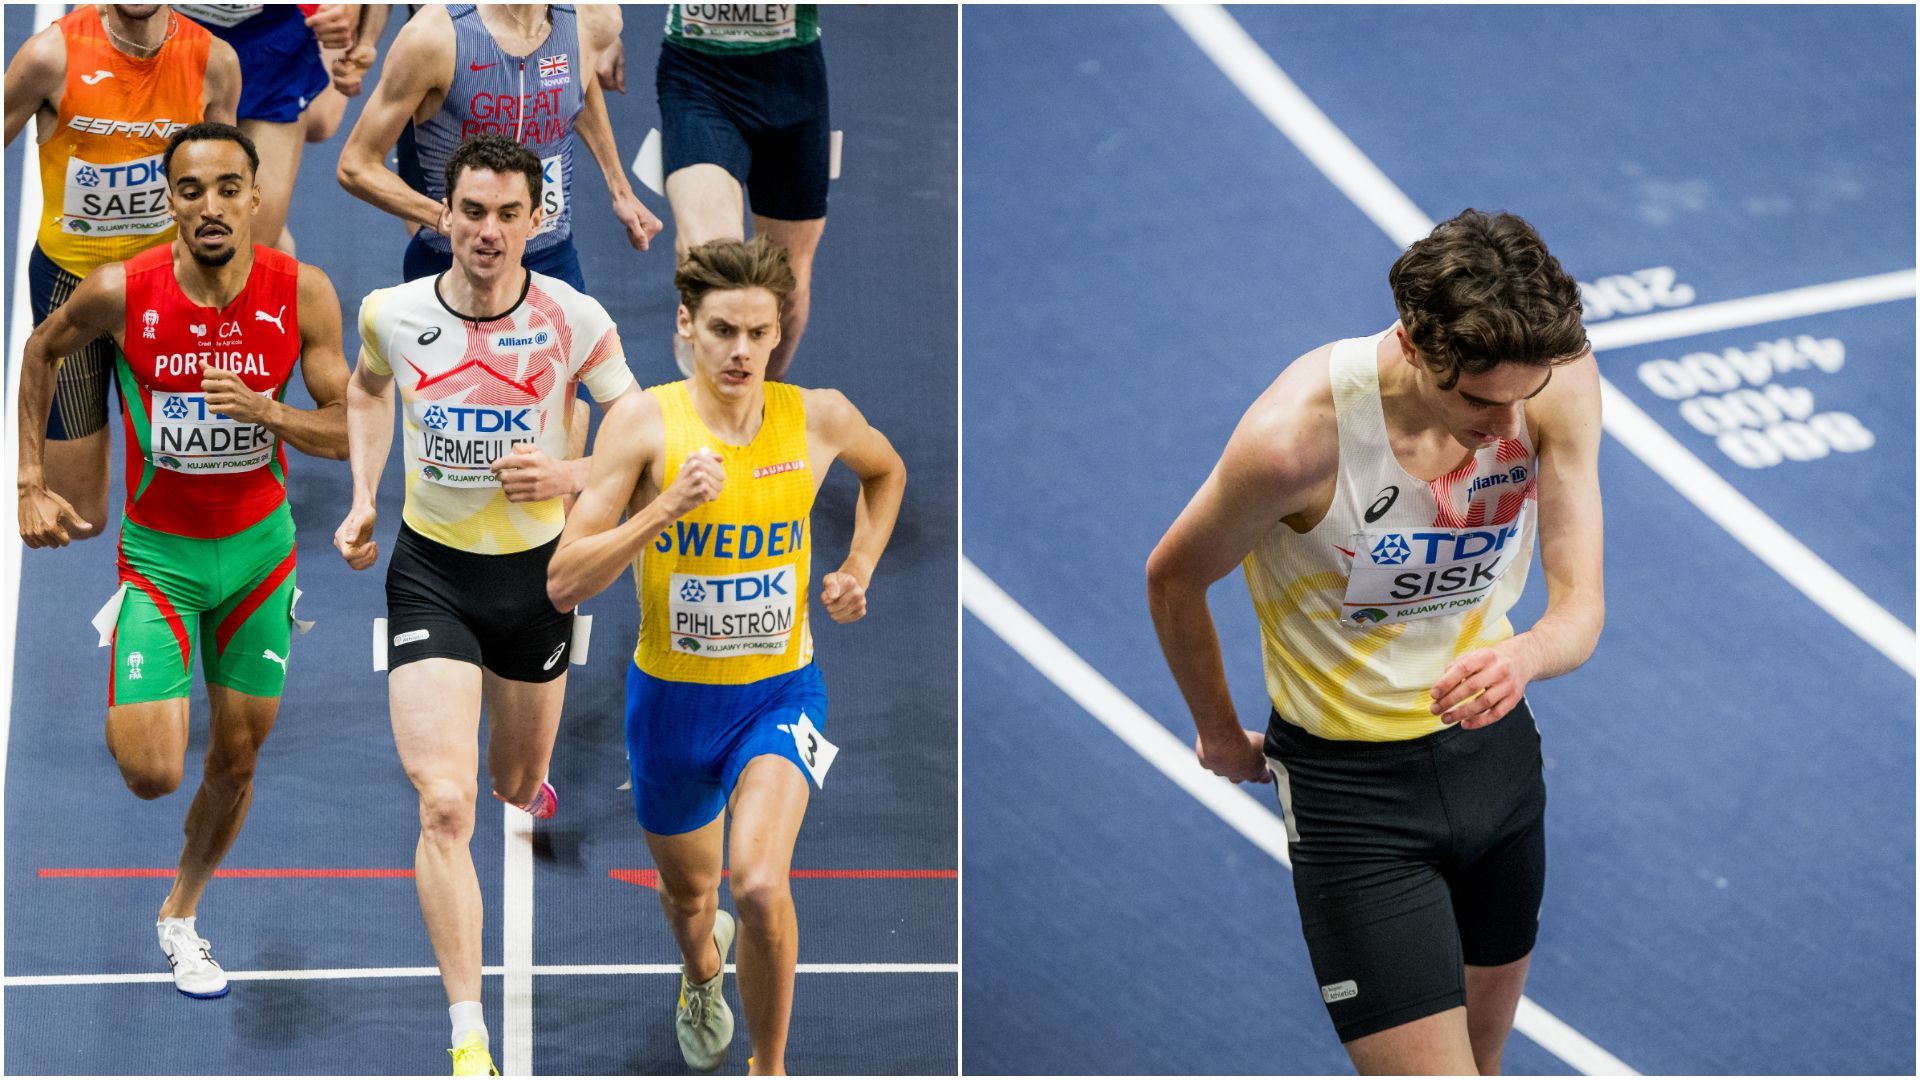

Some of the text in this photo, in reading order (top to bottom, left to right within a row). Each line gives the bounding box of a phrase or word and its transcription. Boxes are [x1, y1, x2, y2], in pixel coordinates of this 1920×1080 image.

[686, 4, 790, 23] GORMLEY
[470, 88, 564, 120] GREAT
[100, 160, 168, 188] TDK
[82, 188, 166, 216] SAEZ
[219, 321, 243, 338] CA
[498, 336, 533, 347] Allianz
[154, 352, 271, 378] PORTUGAL
[447, 407, 533, 433] TDK
[160, 423, 268, 452] NADER
[423, 432, 535, 464] VERMEUL
[187, 461, 221, 470] KUJAWY
[222, 458, 261, 469] POMORZE
[753, 460, 805, 479] BAUHAUS
[448, 474, 481, 482] KUJAWY
[655, 517, 806, 560] SWEDEN
[706, 571, 788, 603] TDK
[1390, 555, 1502, 600] SISK
[676, 605, 792, 636] PIHLSTRÖM
[1397, 602, 1447, 617] KUJAWY
[706, 643, 741, 652] KUJAWY
[743, 640, 783, 650] POMORZE
[805, 732, 818, 768] 3
